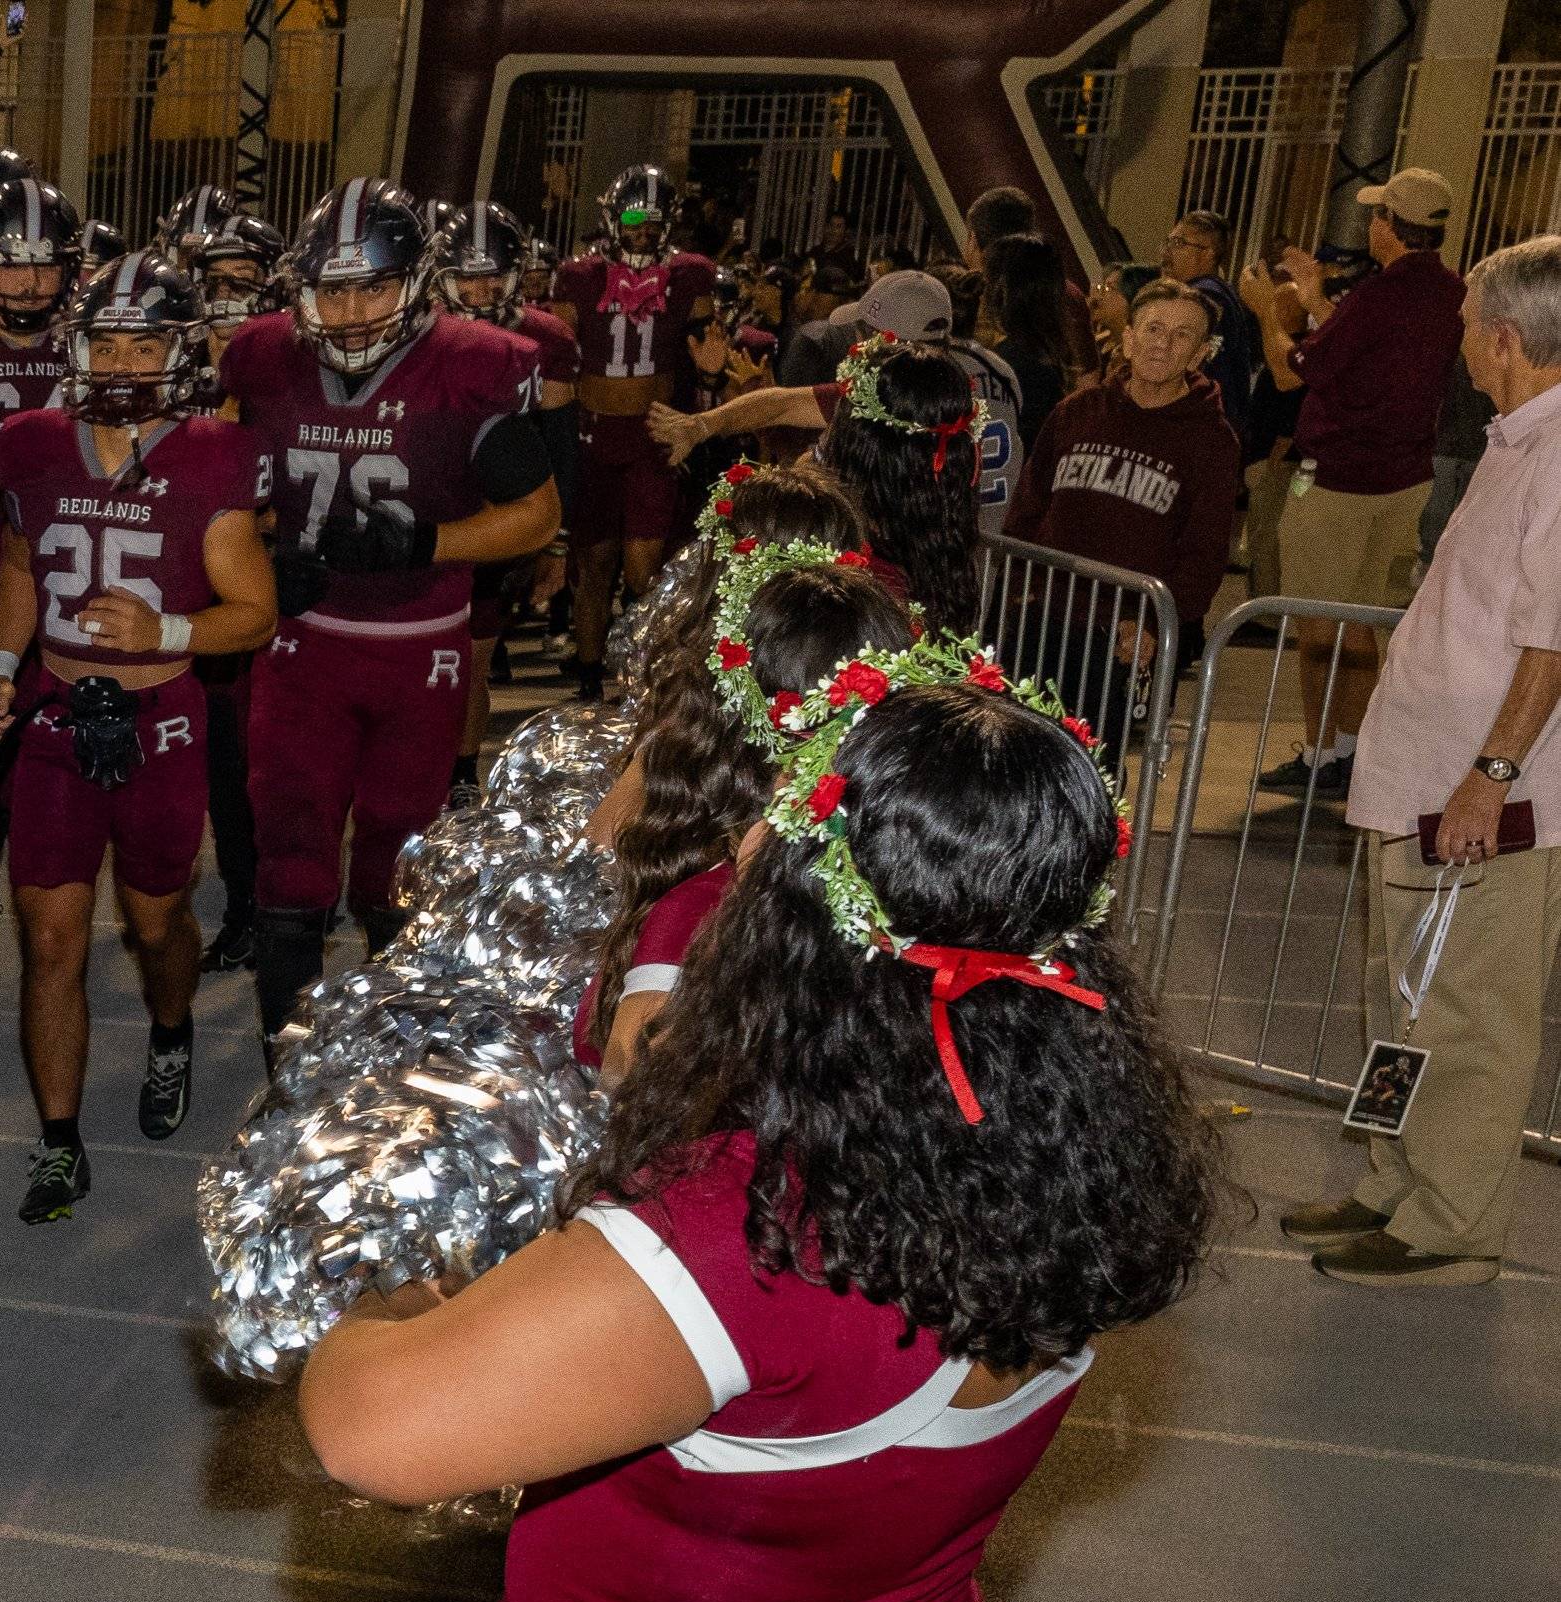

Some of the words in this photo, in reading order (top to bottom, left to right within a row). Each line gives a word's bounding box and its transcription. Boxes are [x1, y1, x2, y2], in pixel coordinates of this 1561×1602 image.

[606, 314, 655, 377] 11
[298, 424, 394, 446] REDLANDS
[58, 497, 152, 522] REDLANDS
[38, 522, 164, 646] 25
[426, 649, 460, 688] R
[155, 715, 194, 753] R
